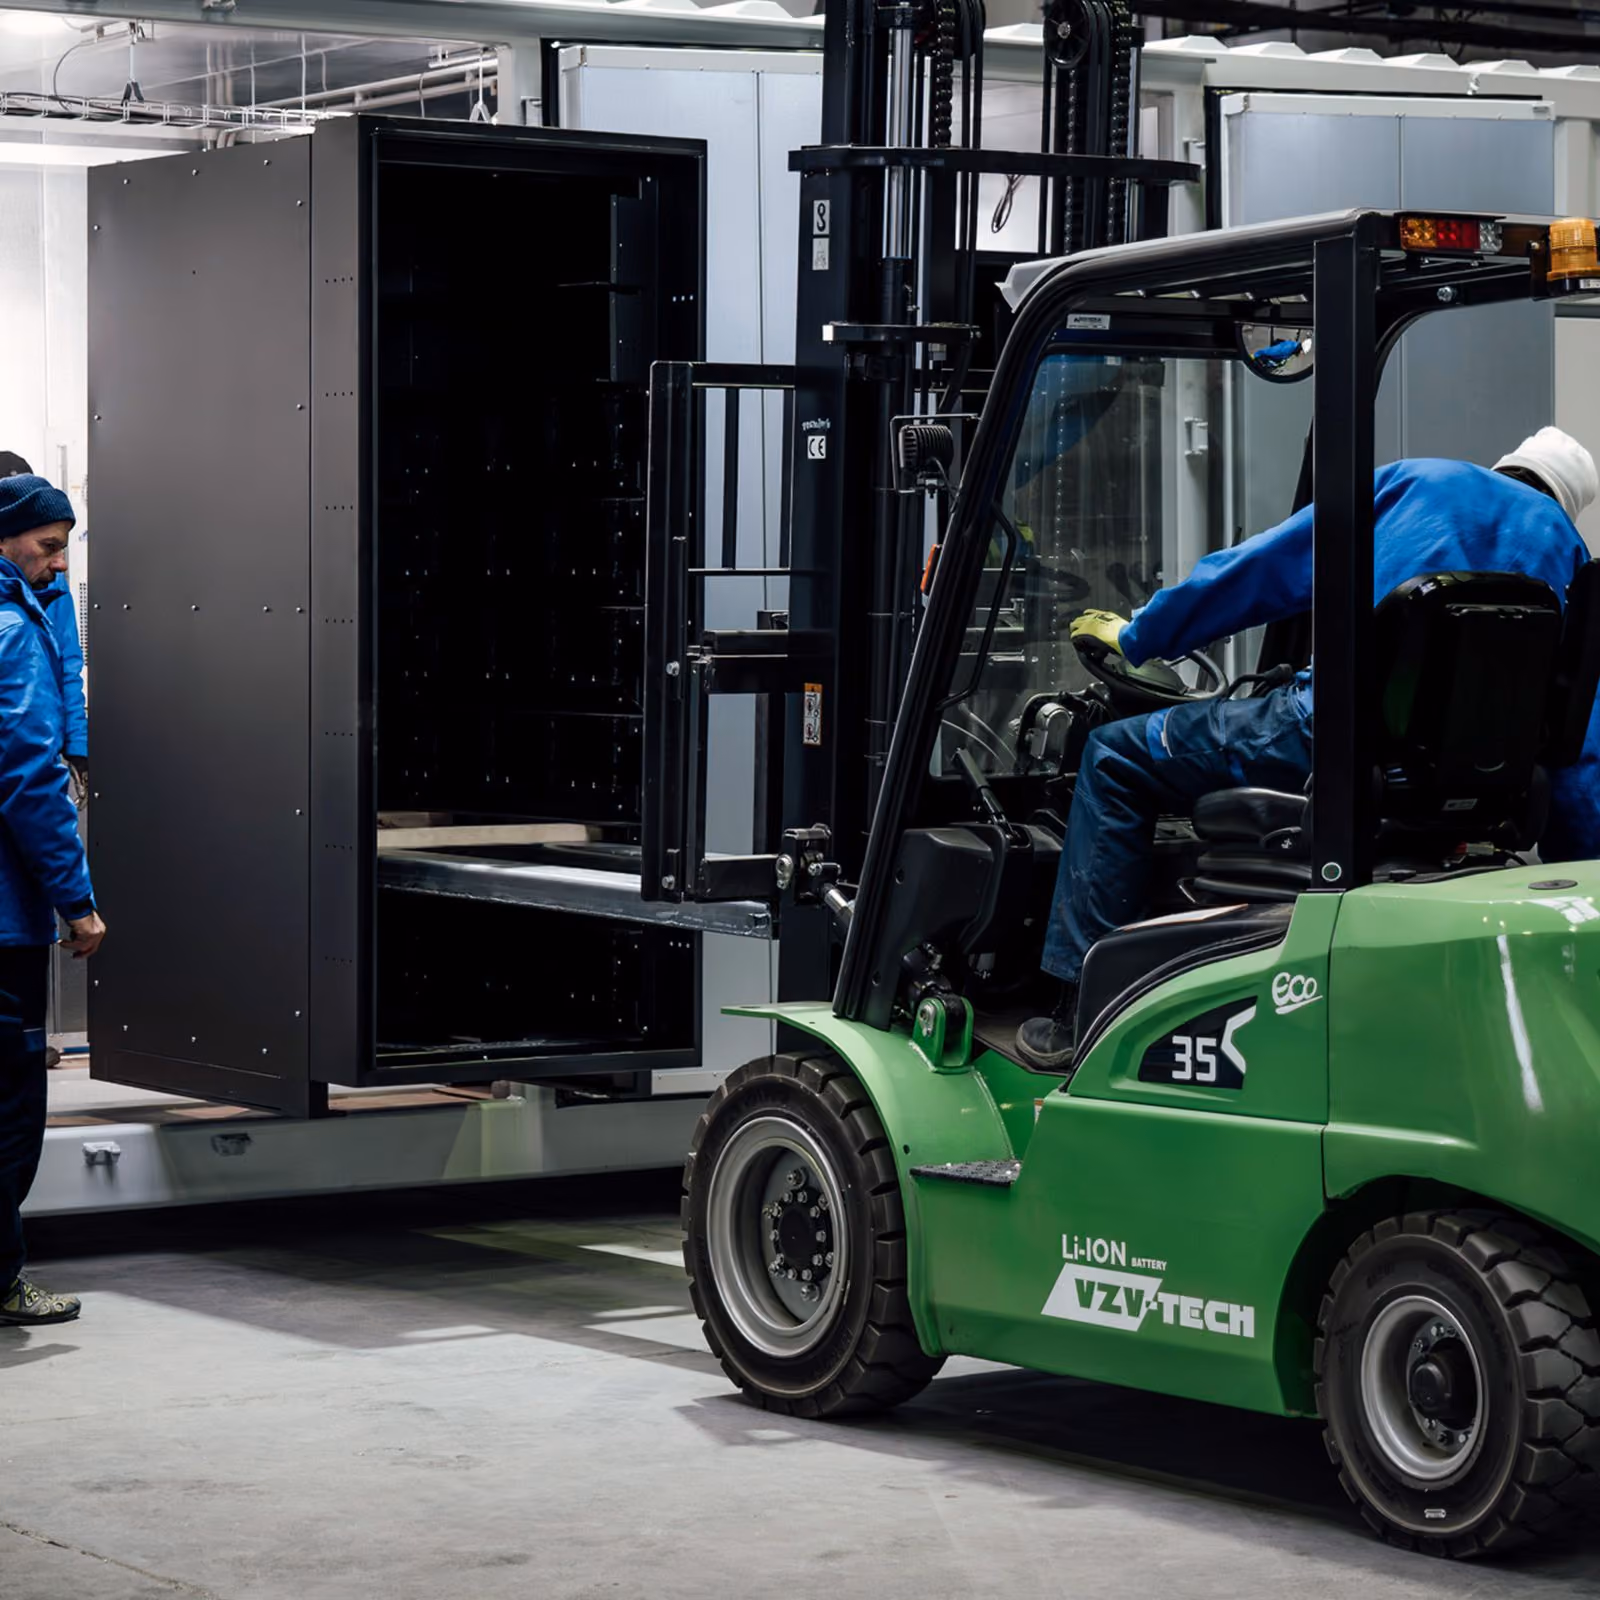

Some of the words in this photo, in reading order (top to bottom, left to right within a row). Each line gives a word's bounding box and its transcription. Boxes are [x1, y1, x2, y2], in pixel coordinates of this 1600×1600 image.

[808, 437, 825, 457] CE
[1171, 1035, 1217, 1082] 35
[1062, 1233, 1126, 1266] Li-ION
[1131, 1256, 1168, 1271] BATTERY
[1073, 1277, 1255, 1338] VZV-TECH
